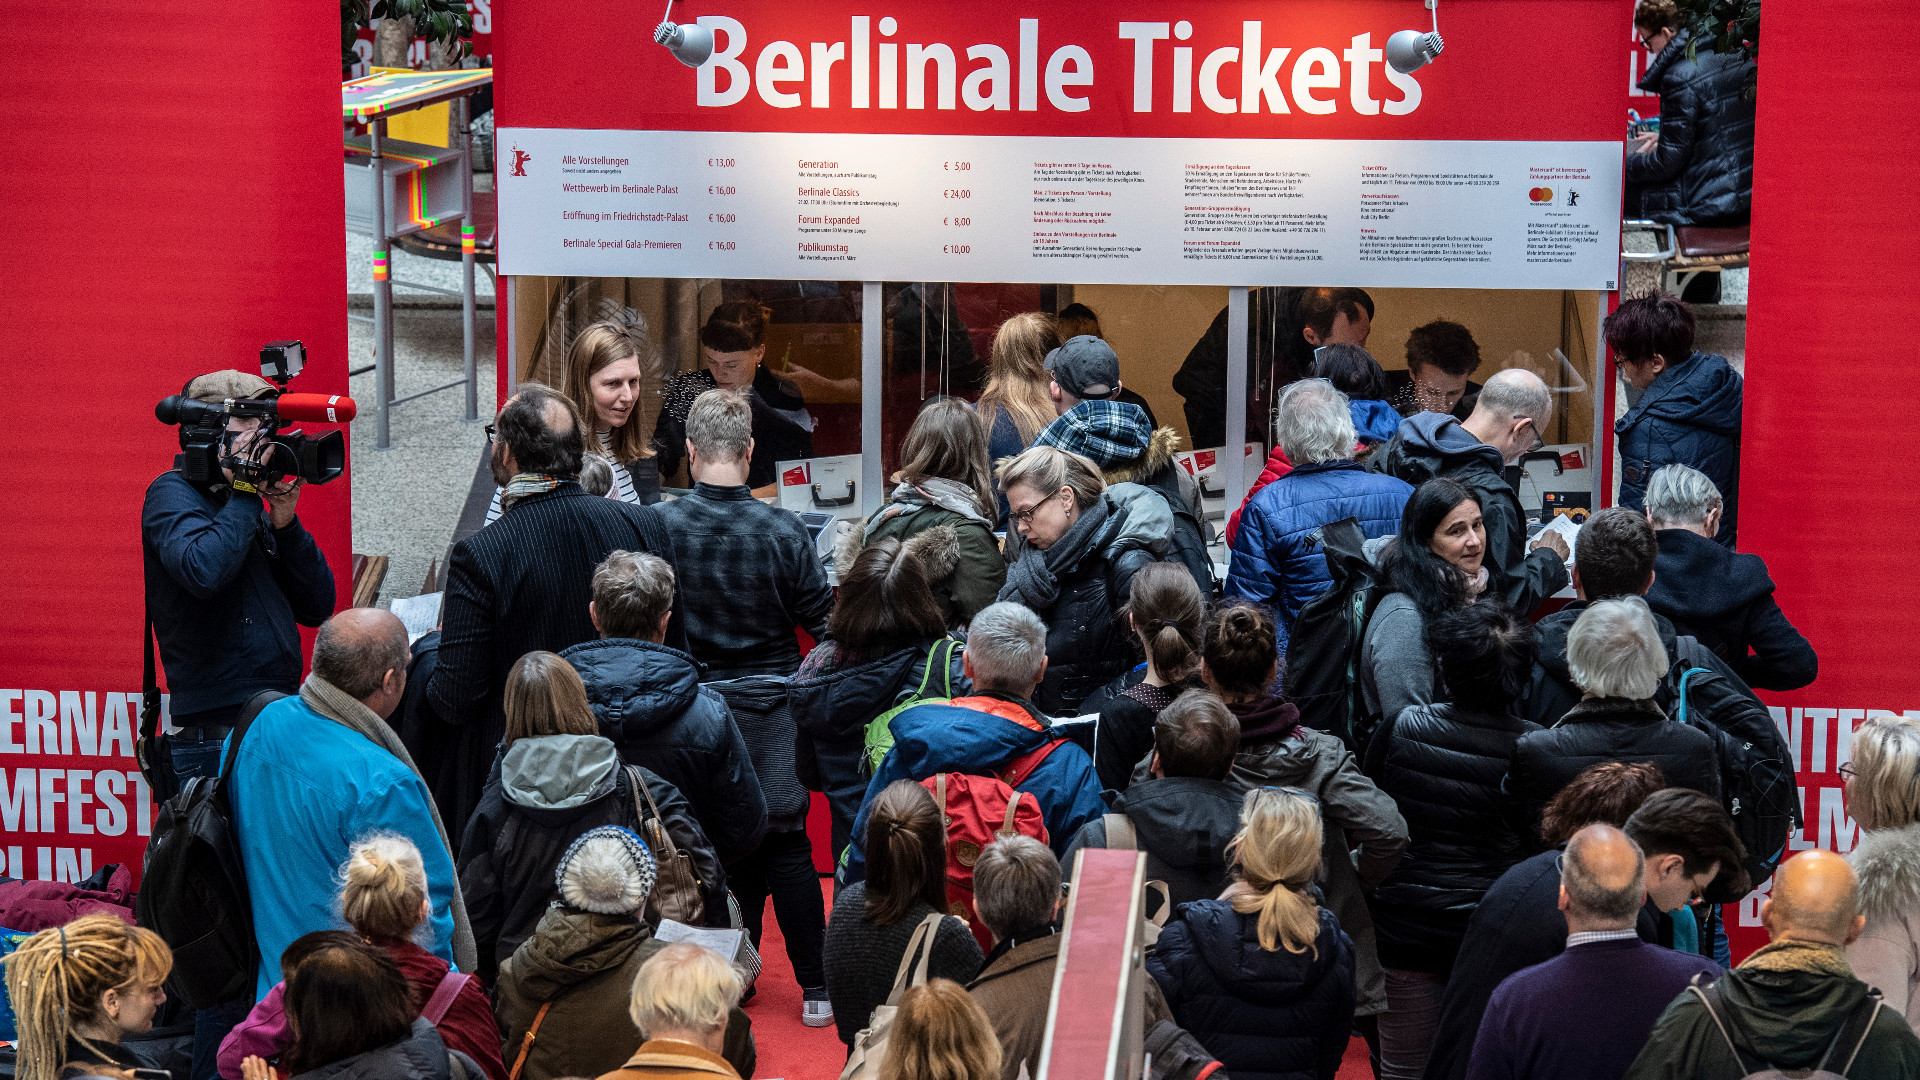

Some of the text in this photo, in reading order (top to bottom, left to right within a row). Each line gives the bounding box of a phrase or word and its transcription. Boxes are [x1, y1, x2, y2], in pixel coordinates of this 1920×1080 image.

[697, 15, 1422, 116] Berlinale Tickets
[563, 155, 628, 167] Alle Vorstellungen
[708, 158, 735, 168] € 13,00
[799, 160, 838, 168] Generation
[944, 162, 970, 172] € 5,00
[563, 183, 678, 194] Wettbewerb im Berlinale Palast
[709, 186, 735, 196] € 16,00
[799, 187, 859, 196] Berlinale Classics
[944, 190, 970, 199] € 24,00
[563, 211, 688, 222] Eröffnung im Friedrichstadt-Palast
[709, 214, 735, 223] € 16,00
[799, 215, 859, 226] Forum Expanded
[944, 217, 970, 227] € 8,00
[564, 239, 681, 250] Berlinale Special Gala-Premieren
[709, 241, 735, 251] € 16,00
[799, 243, 848, 254] Publikumstag
[944, 245, 970, 254] € 10,00
